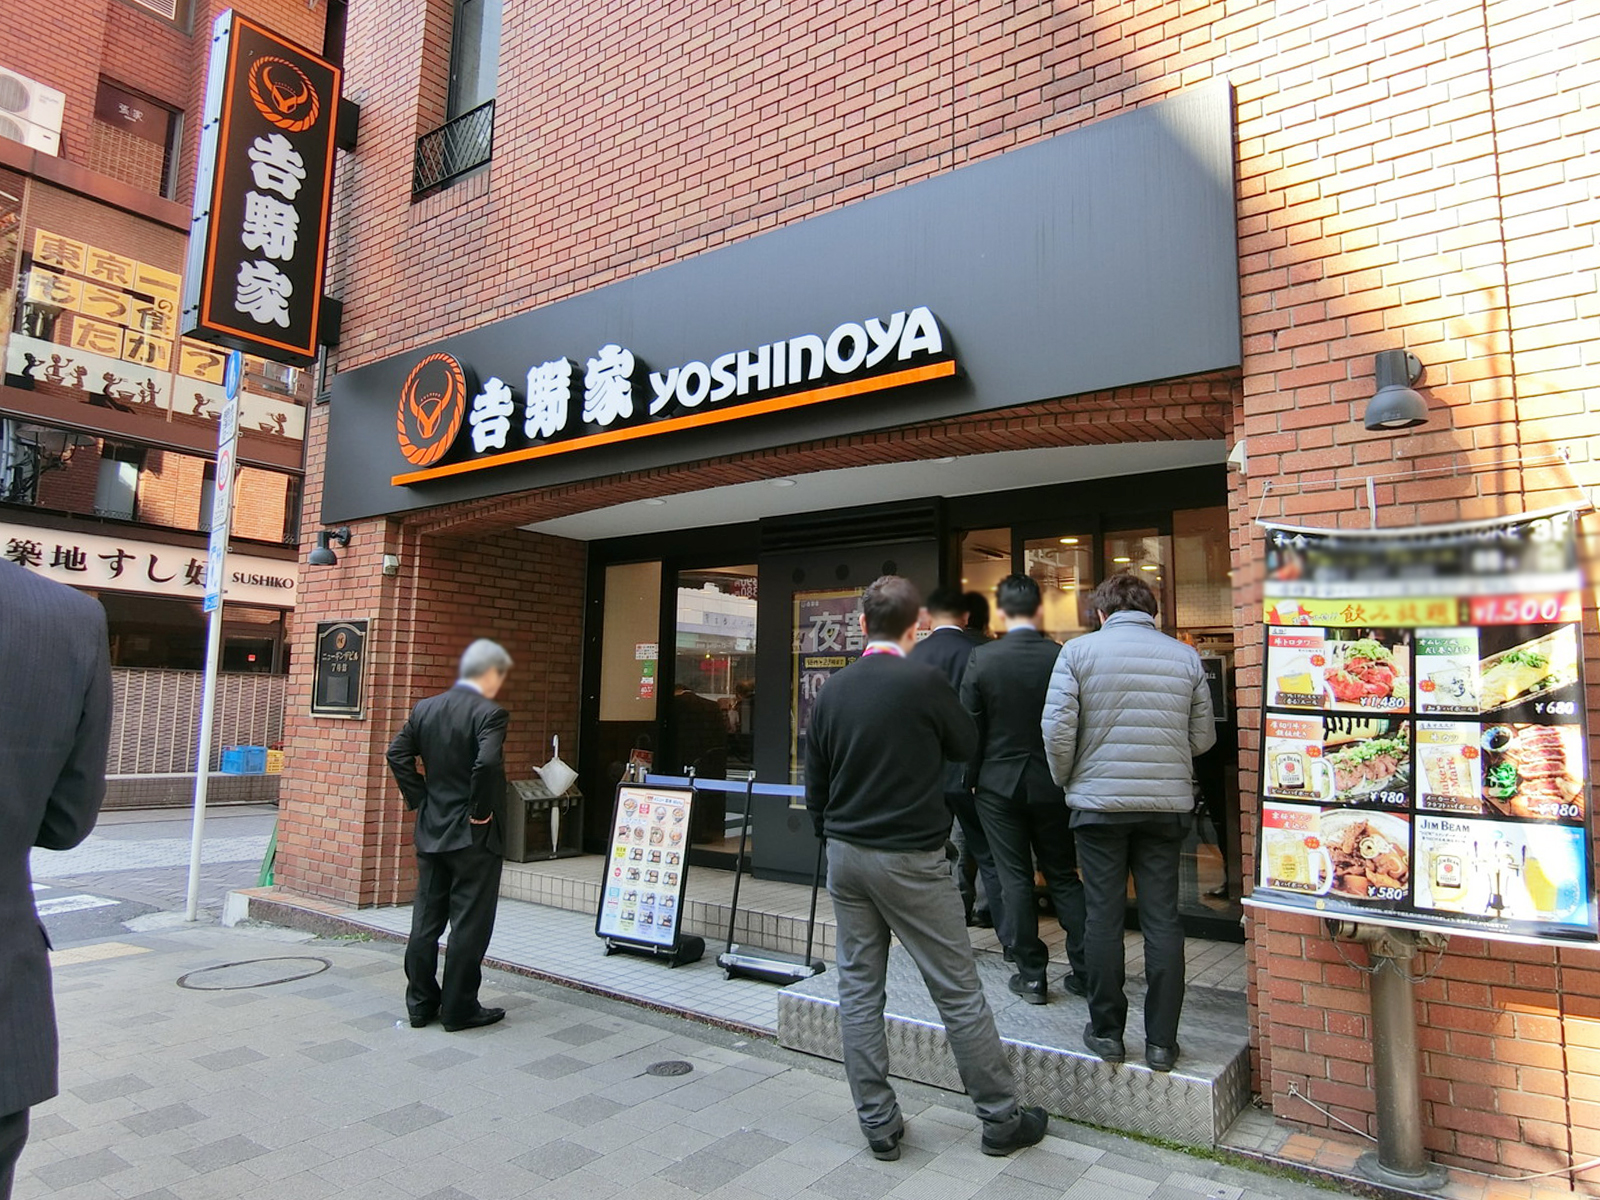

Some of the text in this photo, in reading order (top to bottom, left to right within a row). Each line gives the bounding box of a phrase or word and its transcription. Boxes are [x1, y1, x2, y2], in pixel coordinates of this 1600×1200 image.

[235, 132, 307, 328] 吉野家
[39, 235, 178, 292] 東京一
[469, 306, 943, 454] 吉野家 YOSHINOYA
[232, 571, 295, 590] SUSHIKO
[1360, 696, 1405, 710] ¥1,480
[1535, 701, 1575, 715] ¥680
[1369, 790, 1405, 804] ¥980
[1420, 819, 1470, 833] JIM BEAM
[1368, 886, 1404, 900] ¥580
